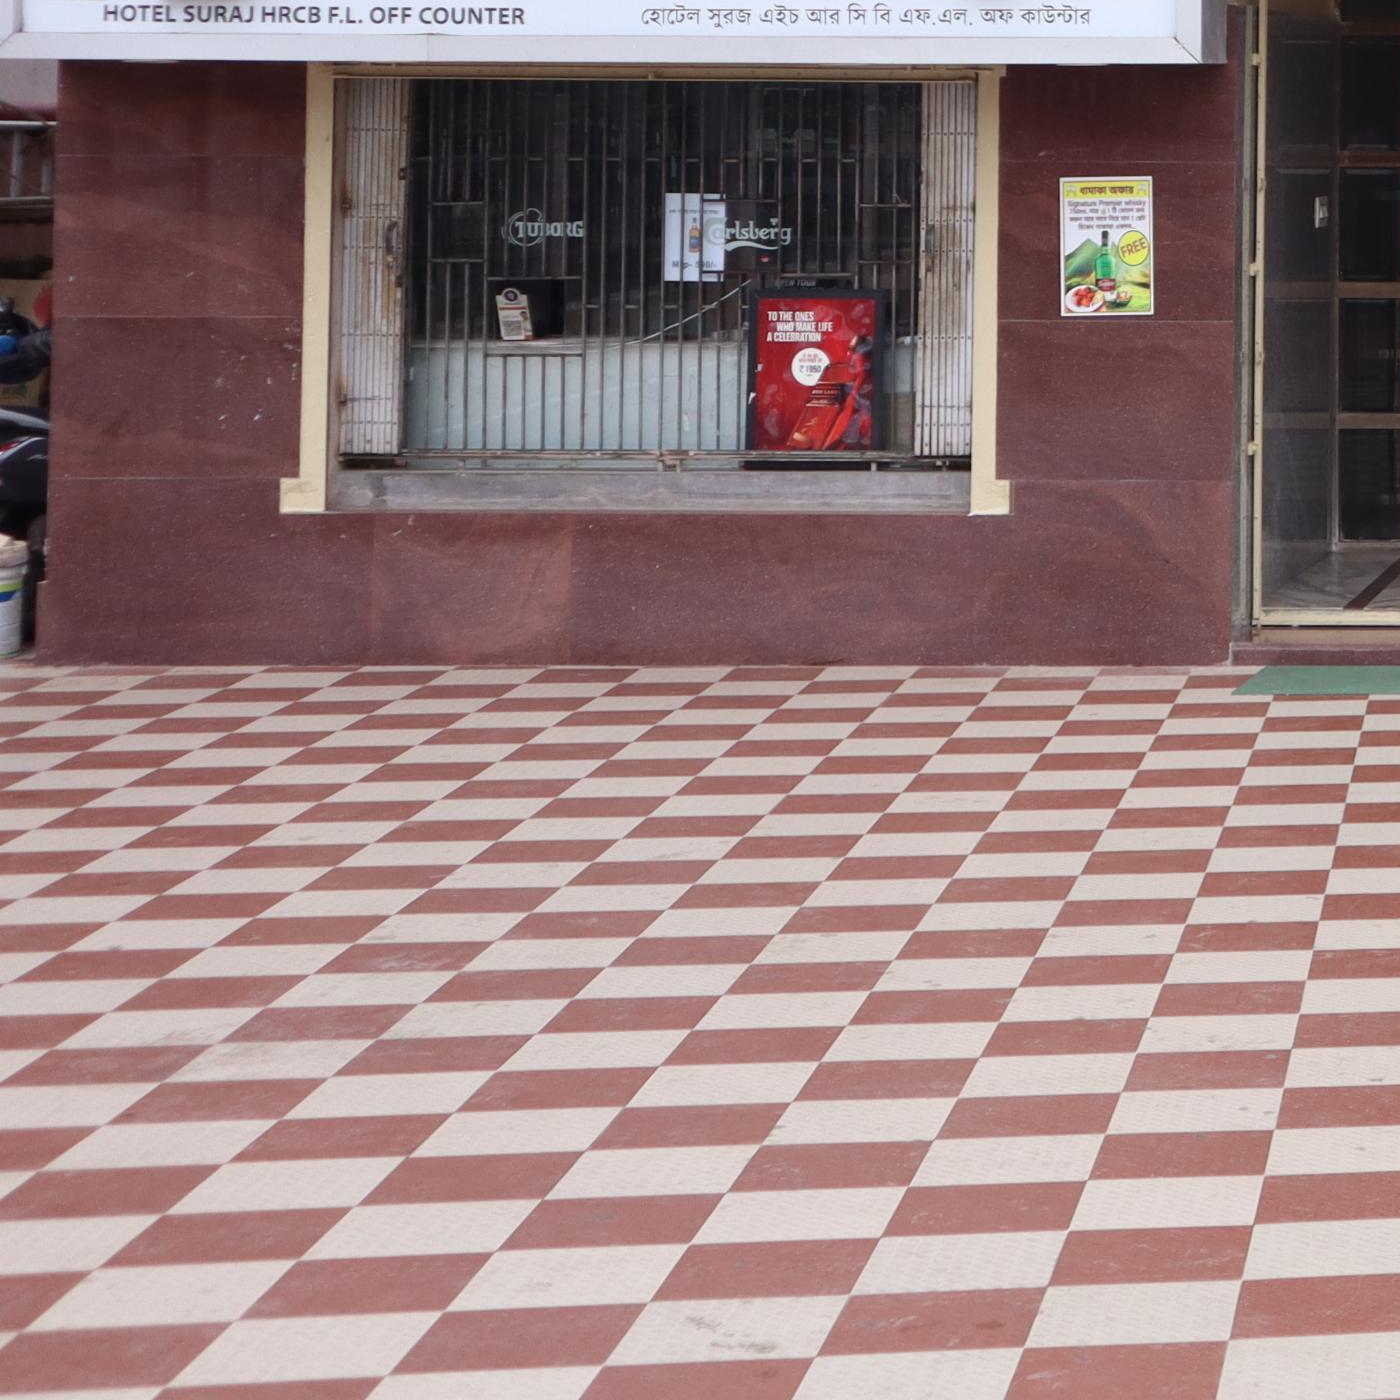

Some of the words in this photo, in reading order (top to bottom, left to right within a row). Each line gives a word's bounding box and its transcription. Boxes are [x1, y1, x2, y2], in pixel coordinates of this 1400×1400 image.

[103, 4, 177, 23] HOTEL
[182, 5, 254, 24] SURAJ
[261, 6, 321, 24] HRCB
[328, 7, 363, 24] F.L.
[369, 7, 412, 24] OFF
[418, 7, 525, 25] COUNTER
[640, 2, 700, 26] হোটেল
[707, 7, 751, 29] সুরজ
[759, 3, 800, 25] এইচ
[805, 6, 840, 25] আর
[847, 2, 867, 25] সি
[873, 2, 891, 25] বি
[979, 6, 1013, 25] অফ
[1020, 2, 1092, 25] কাউন্টার
[703, 217, 793, 247] Carlsberg
[1120, 237, 1148, 258] FREE
[767, 311, 777, 321] TO
[779, 311, 794, 321] THE
[795, 311, 815, 321] ONES
[776, 321, 794, 332] WHO
[795, 321, 816, 332] MAKE
[818, 322, 833, 332] LIFE
[766, 332, 772, 342] A
[773, 332, 822, 342] CELEBRATION
